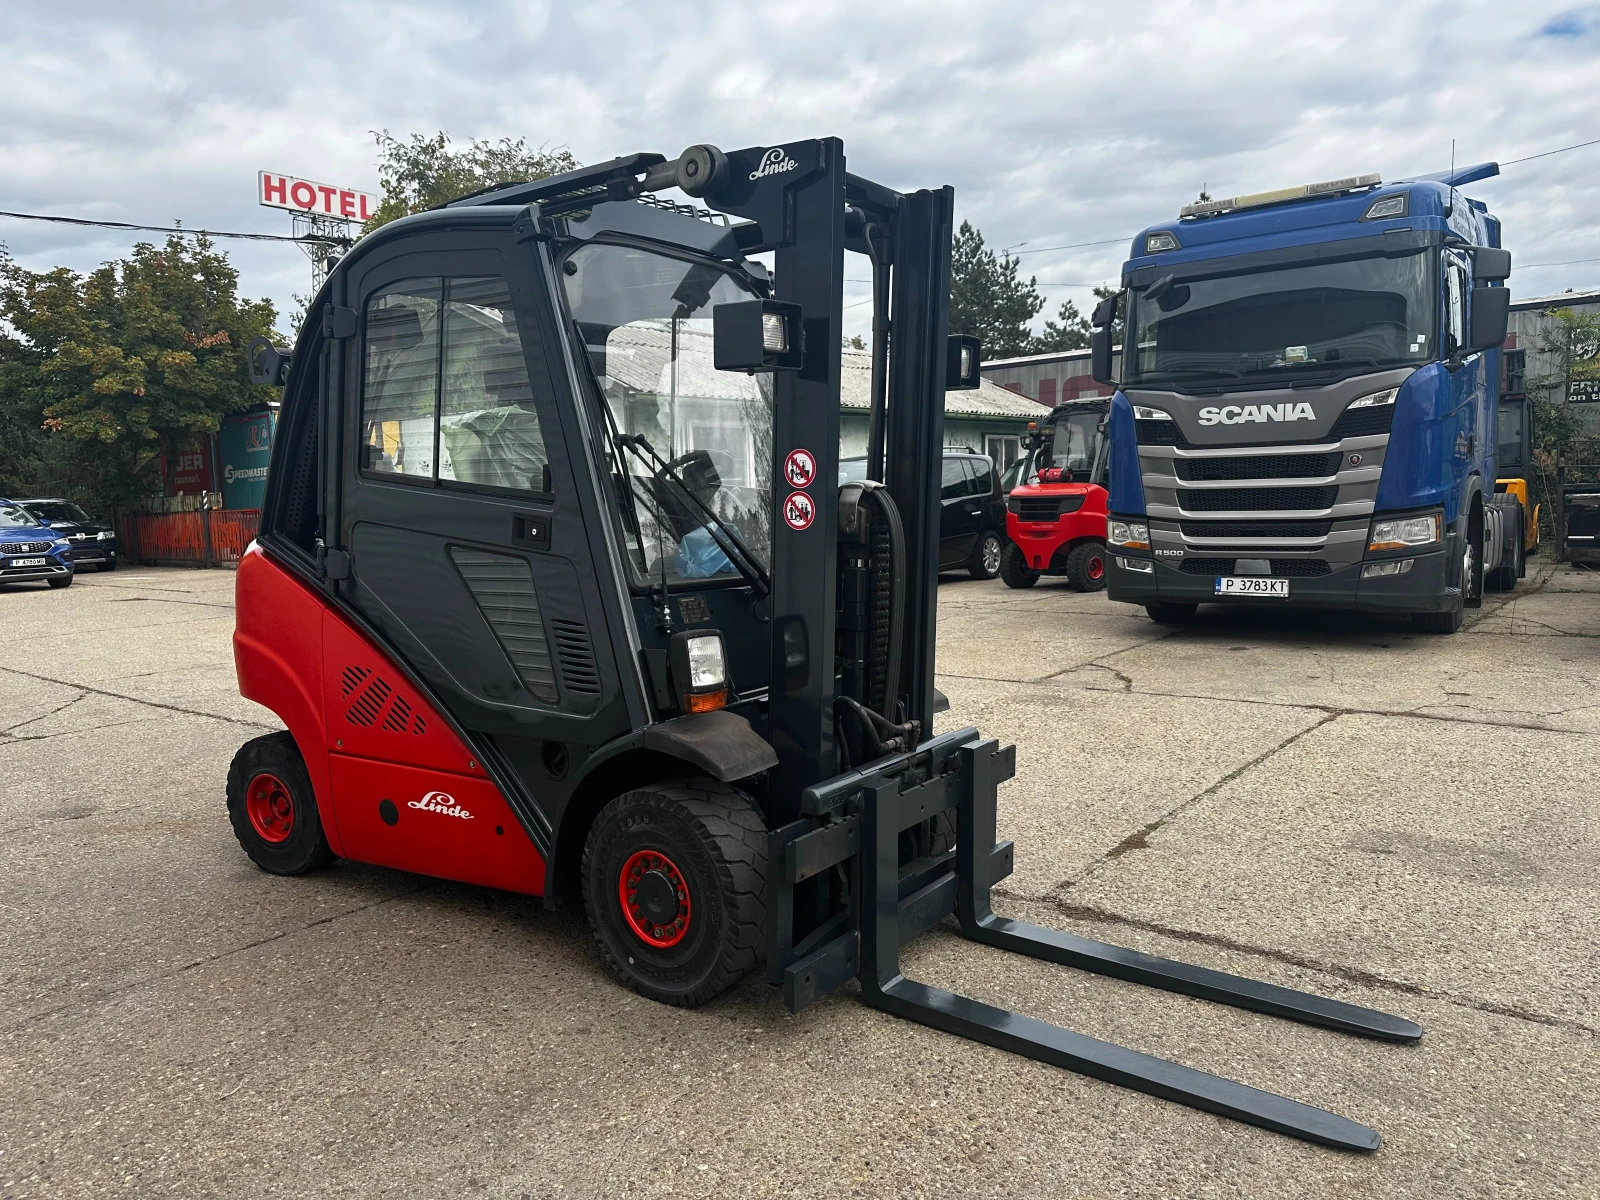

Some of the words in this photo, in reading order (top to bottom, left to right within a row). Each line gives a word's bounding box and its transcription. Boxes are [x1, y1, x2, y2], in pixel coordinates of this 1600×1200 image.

[748, 147, 799, 180] Linde
[263, 174, 375, 220] HOTEL
[1591, 392, 1600, 401] t
[1197, 402, 1317, 426] SCANIA
[224, 464, 270, 484] SPEEDMASTE
[1226, 579, 1234, 591] P
[407, 791, 475, 819] Linde
